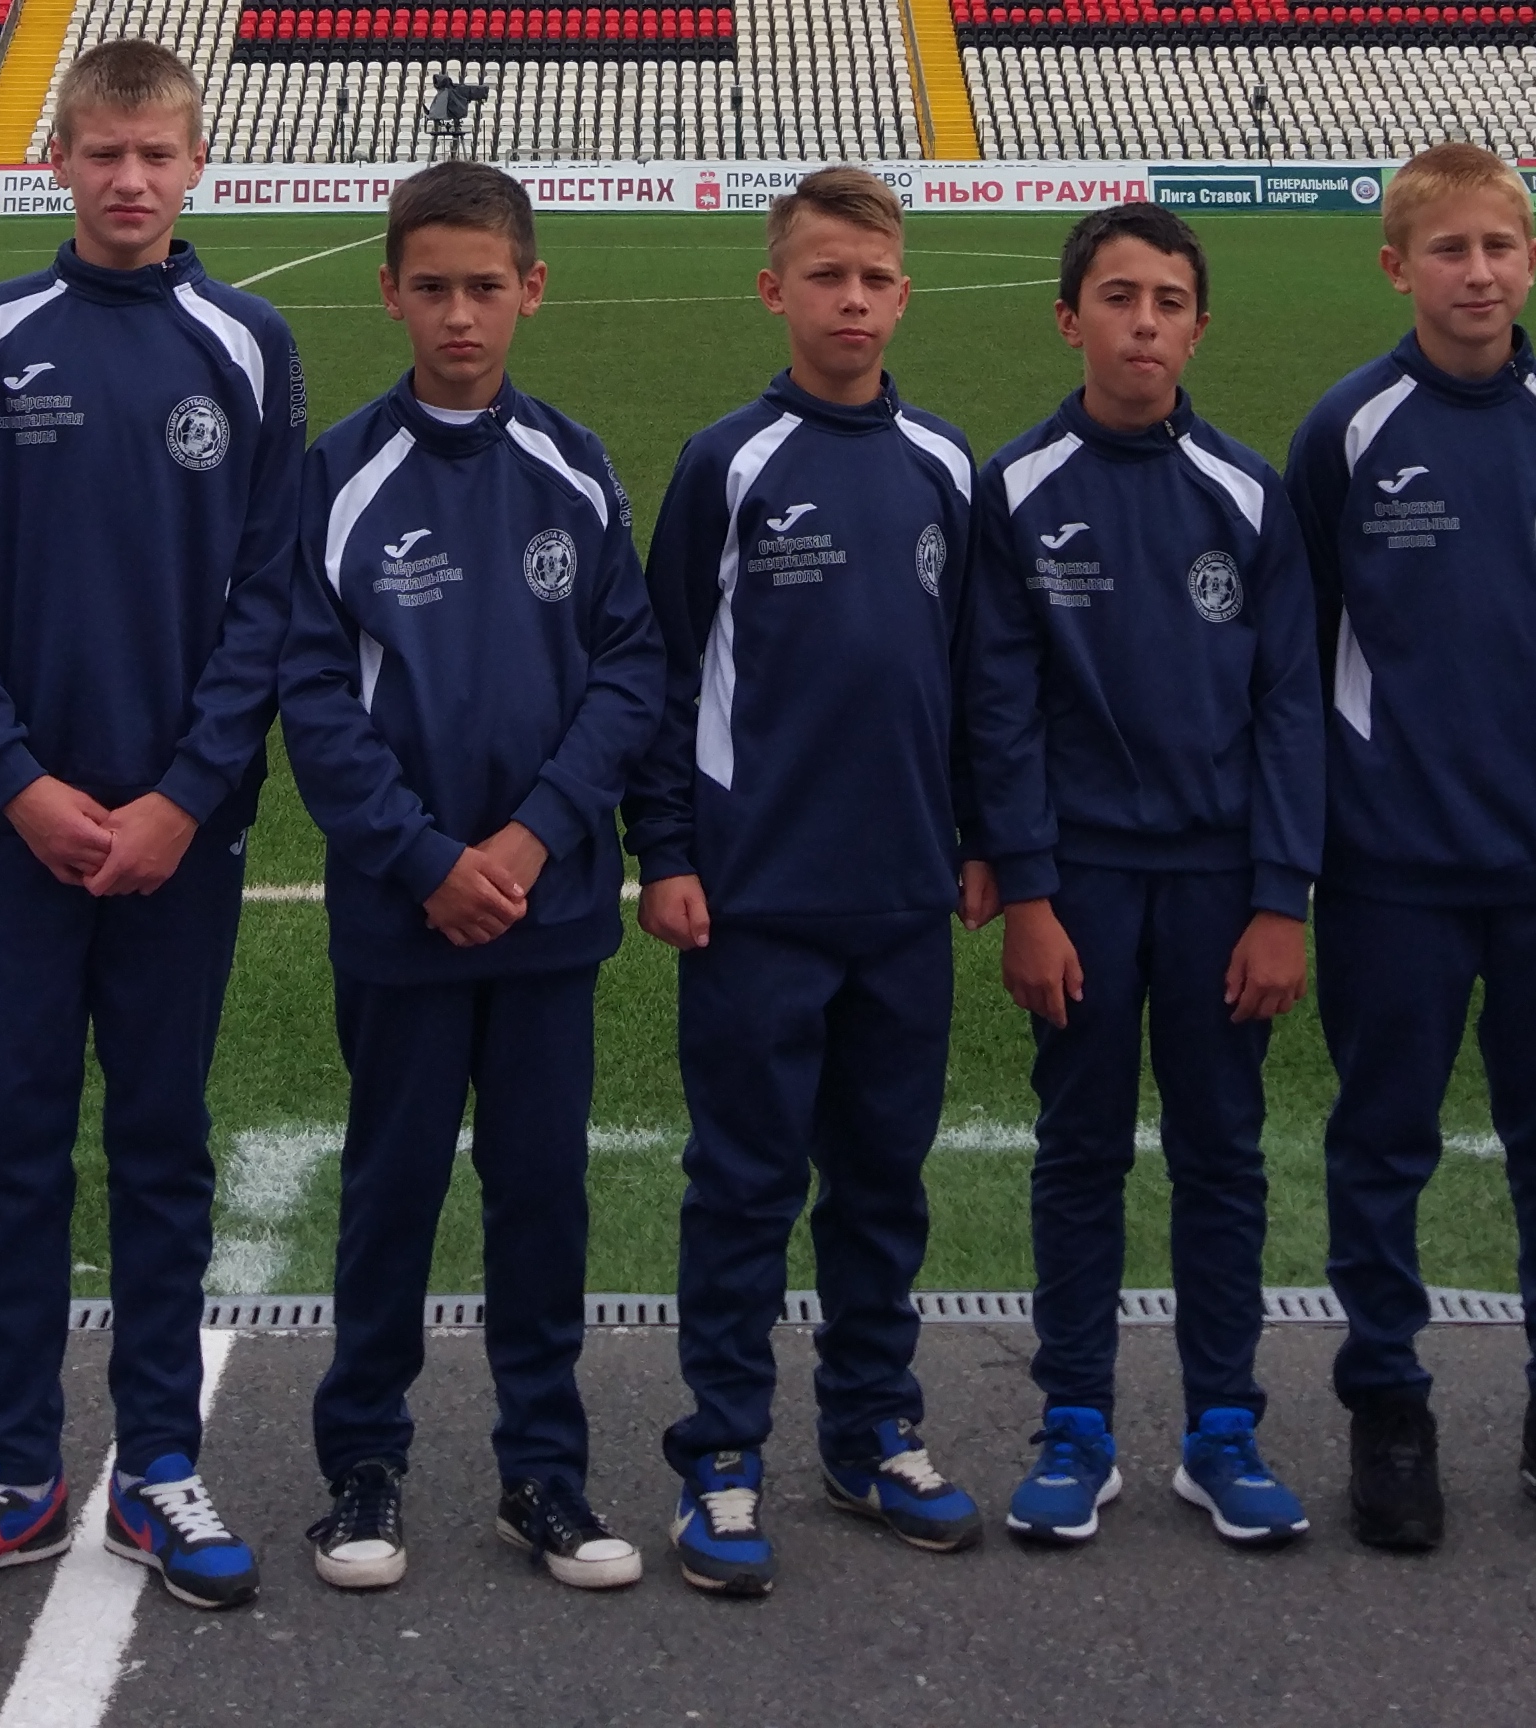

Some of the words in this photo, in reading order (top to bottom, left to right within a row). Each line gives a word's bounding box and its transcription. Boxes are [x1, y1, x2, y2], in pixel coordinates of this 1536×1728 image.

[214, 179, 404, 203] РОСГОССТР
[924, 181, 1004, 203] НЬЮ
[1016, 180, 1148, 203] ГРАУНД
[1267, 177, 1348, 191] ГЕНЕРАЛЬНЫЙ
[1159, 188, 1196, 204] Лига
[1199, 188, 1252, 204] Ставок
[1267, 192, 1319, 204] ПАРТНЕР
